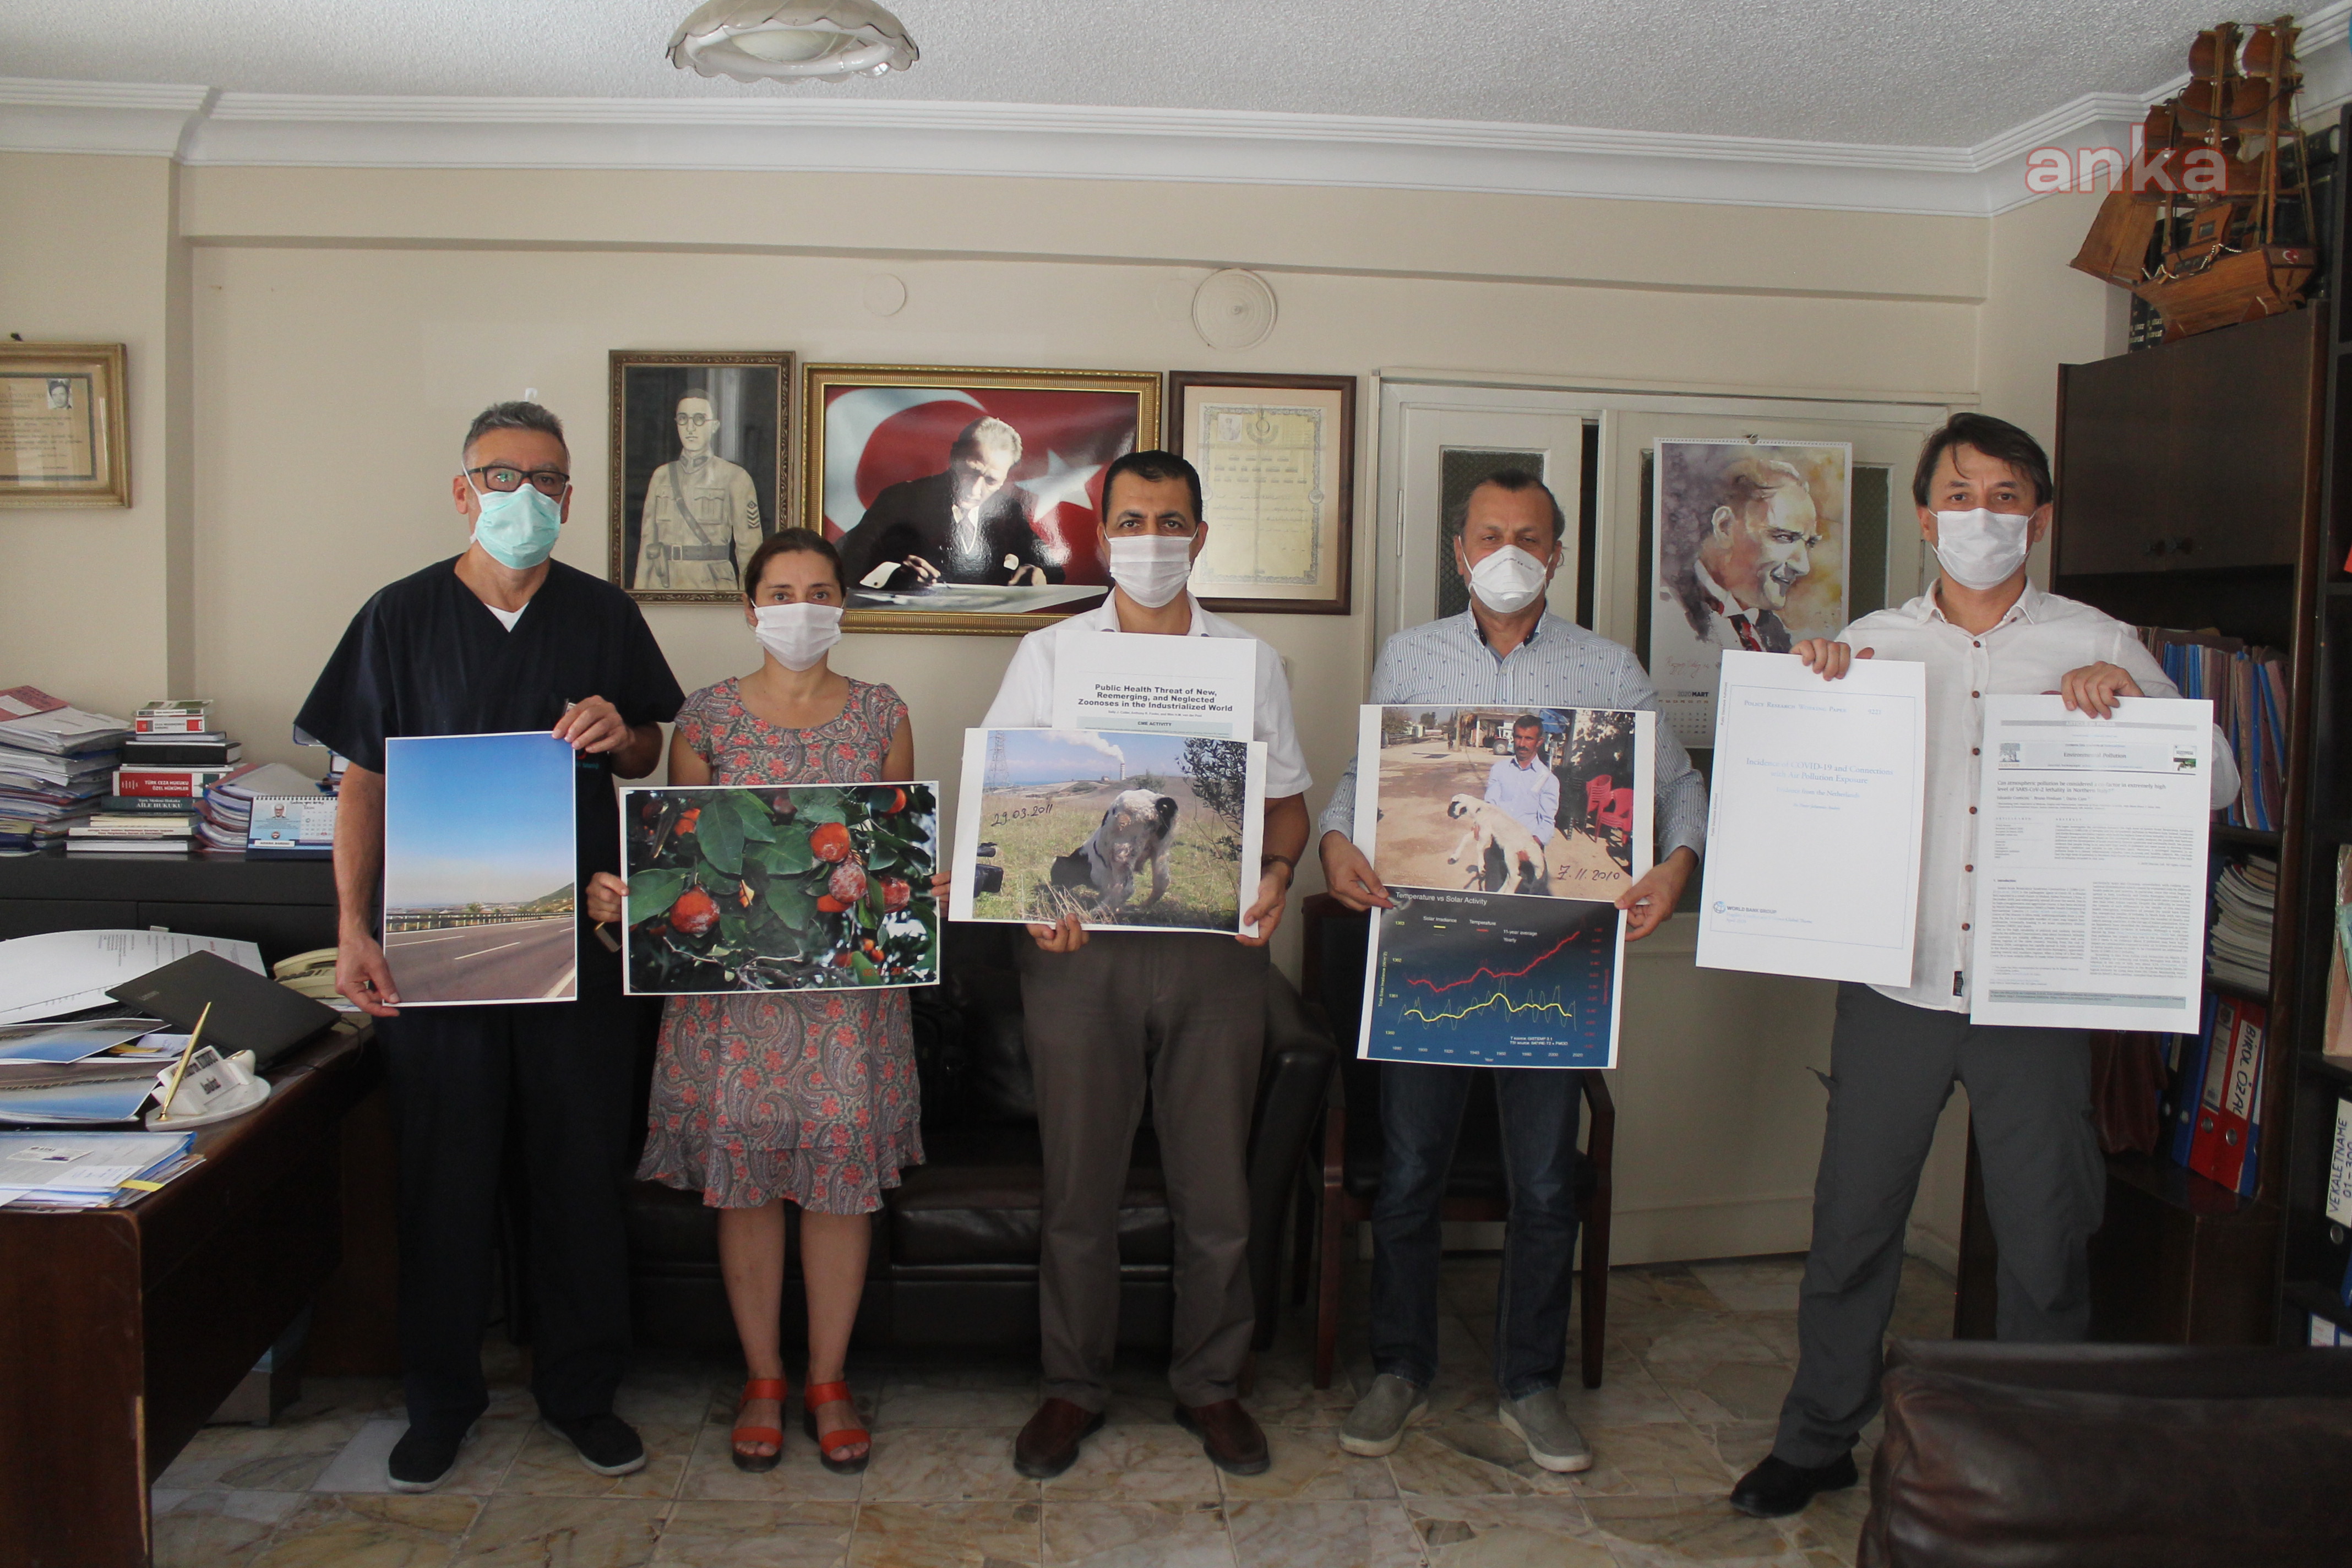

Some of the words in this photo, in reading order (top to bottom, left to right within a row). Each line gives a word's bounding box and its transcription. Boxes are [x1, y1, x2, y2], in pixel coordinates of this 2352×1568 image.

[1097, 692, 1150, 702] Reemerging,
[1171, 695, 1215, 704] Neglected
[1196, 688, 1217, 696] New,
[1078, 699, 1119, 707] Zoonoses
[1148, 701, 1206, 710] Industrialized
[1746, 758, 1779, 767] Incidence
[1790, 761, 1832, 771] COVID-19
[1849, 766, 1893, 776] Connections
[1801, 772, 1833, 782] Pollution
[1836, 775, 1868, 785] Exposure
[1827, 790, 1860, 798] Netherlands
[1396, 891, 1435, 901] Temperature
[1464, 897, 1488, 906] Activity
[2329, 1117, 2347, 1212] VEKALETNAME
[2343, 1182, 2352, 1199] 01
